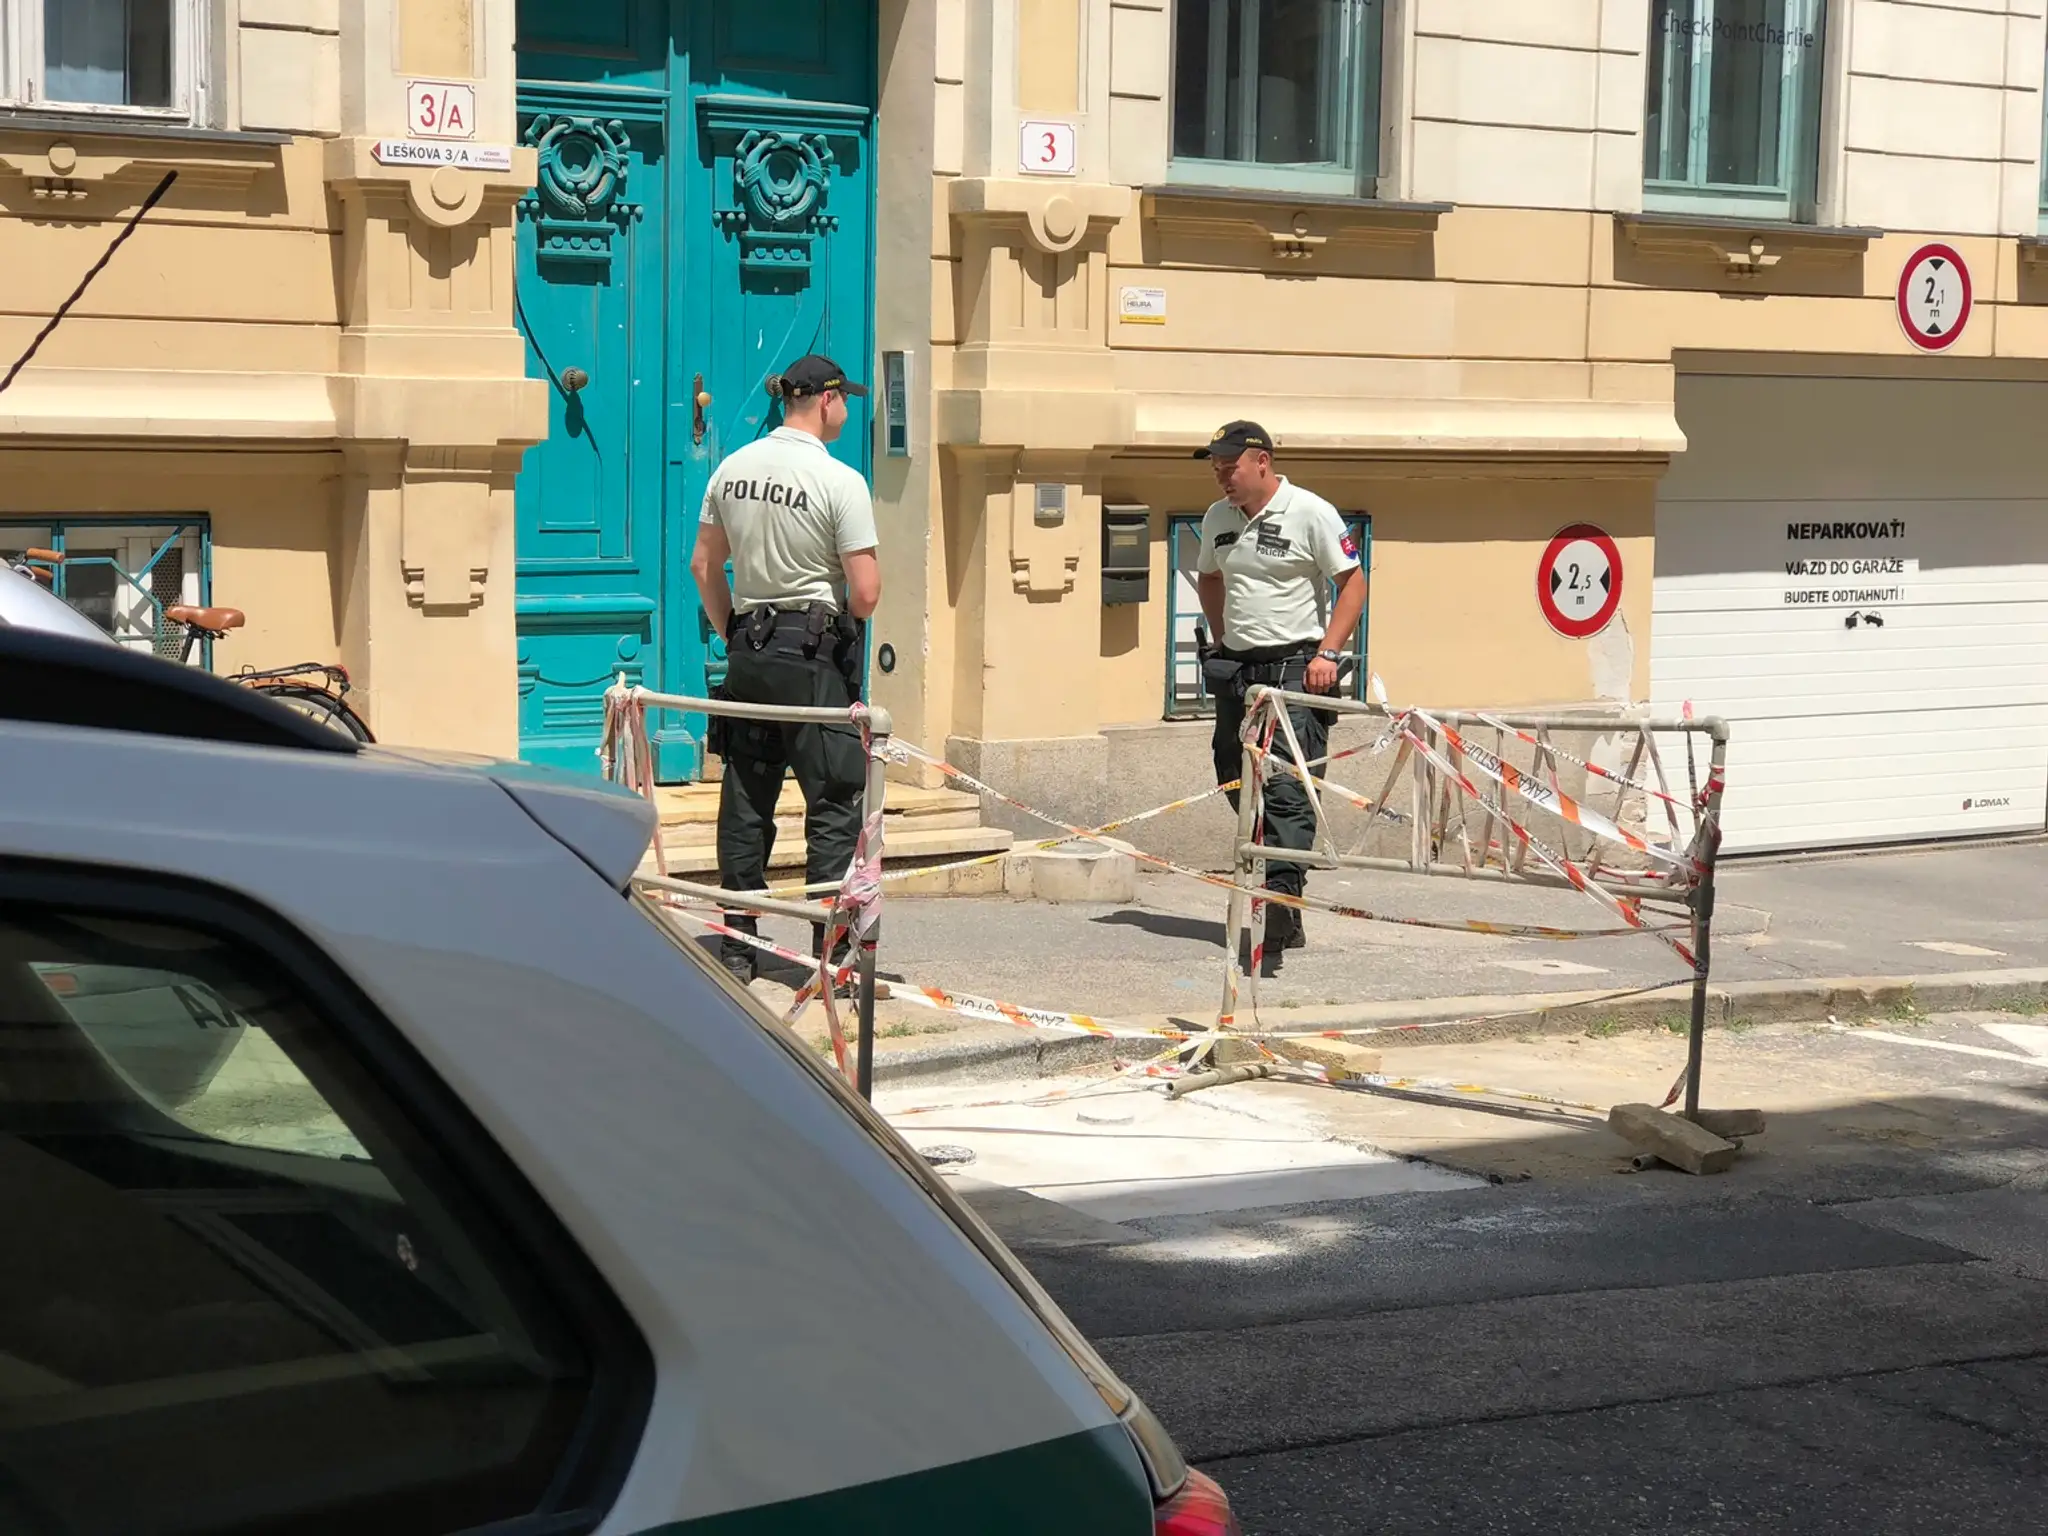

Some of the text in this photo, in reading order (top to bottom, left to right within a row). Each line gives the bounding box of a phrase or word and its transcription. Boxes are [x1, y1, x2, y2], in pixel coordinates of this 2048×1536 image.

[1658, 12, 1814, 48] CheckPointCharlie
[420, 89, 464, 133] 3/A
[386, 143, 441, 160] LEŠKOVA
[445, 149, 469, 162] 3/A
[1040, 132, 1057, 162] 3
[1924, 276, 1945, 307] 2,1
[1929, 309, 1940, 318] m
[722, 476, 808, 512] POLÍCIA
[1787, 518, 1906, 540] NEPARKOVAŤ!
[1785, 557, 1904, 575] VJAZD DO GARÁŽE
[1568, 563, 1592, 592] 2,5
[1576, 596, 1585, 605] m
[1784, 590, 1829, 604] BUDETE
[1974, 797, 2010, 808] LOMAX
